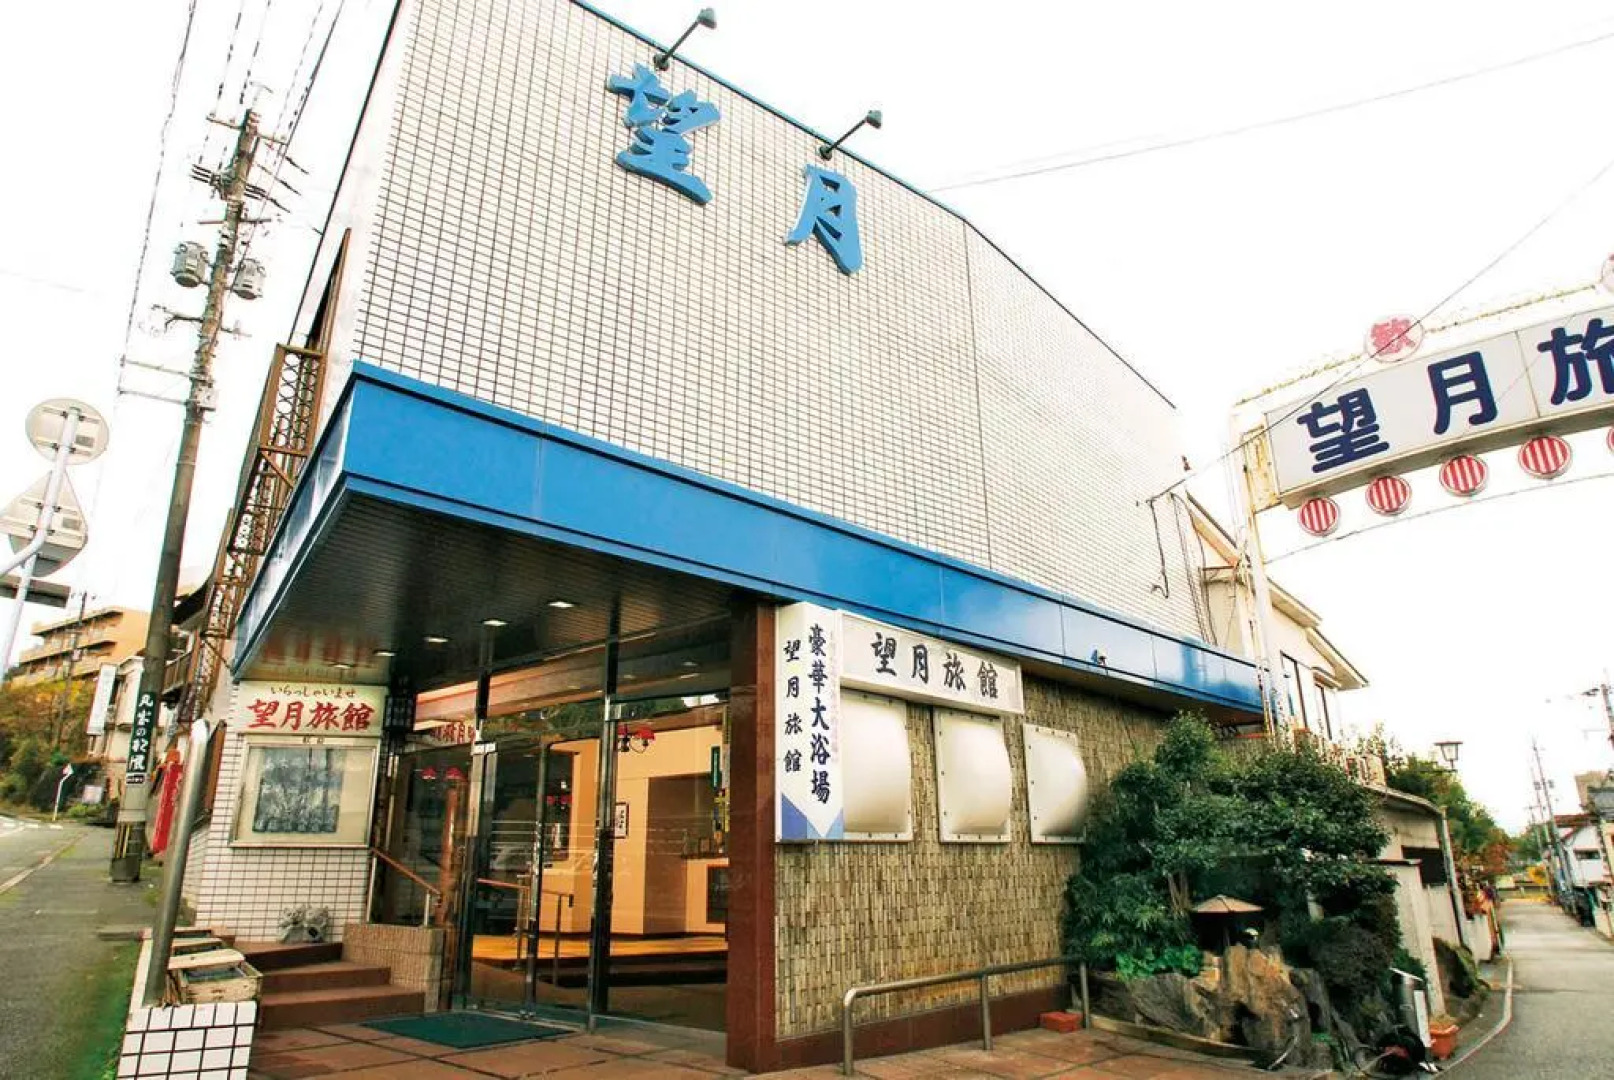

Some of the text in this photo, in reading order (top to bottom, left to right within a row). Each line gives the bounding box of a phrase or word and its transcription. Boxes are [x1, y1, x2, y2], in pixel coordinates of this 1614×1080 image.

[606, 62, 863, 275] 望月
[246, 698, 375, 731] 望月旅館
[271, 683, 356, 698] いらっしゃいませ
[783, 639, 803, 772] 望月旅館
[808, 623, 831, 804] 豪華大浴場
[870, 631, 998, 698] 望月旅館
